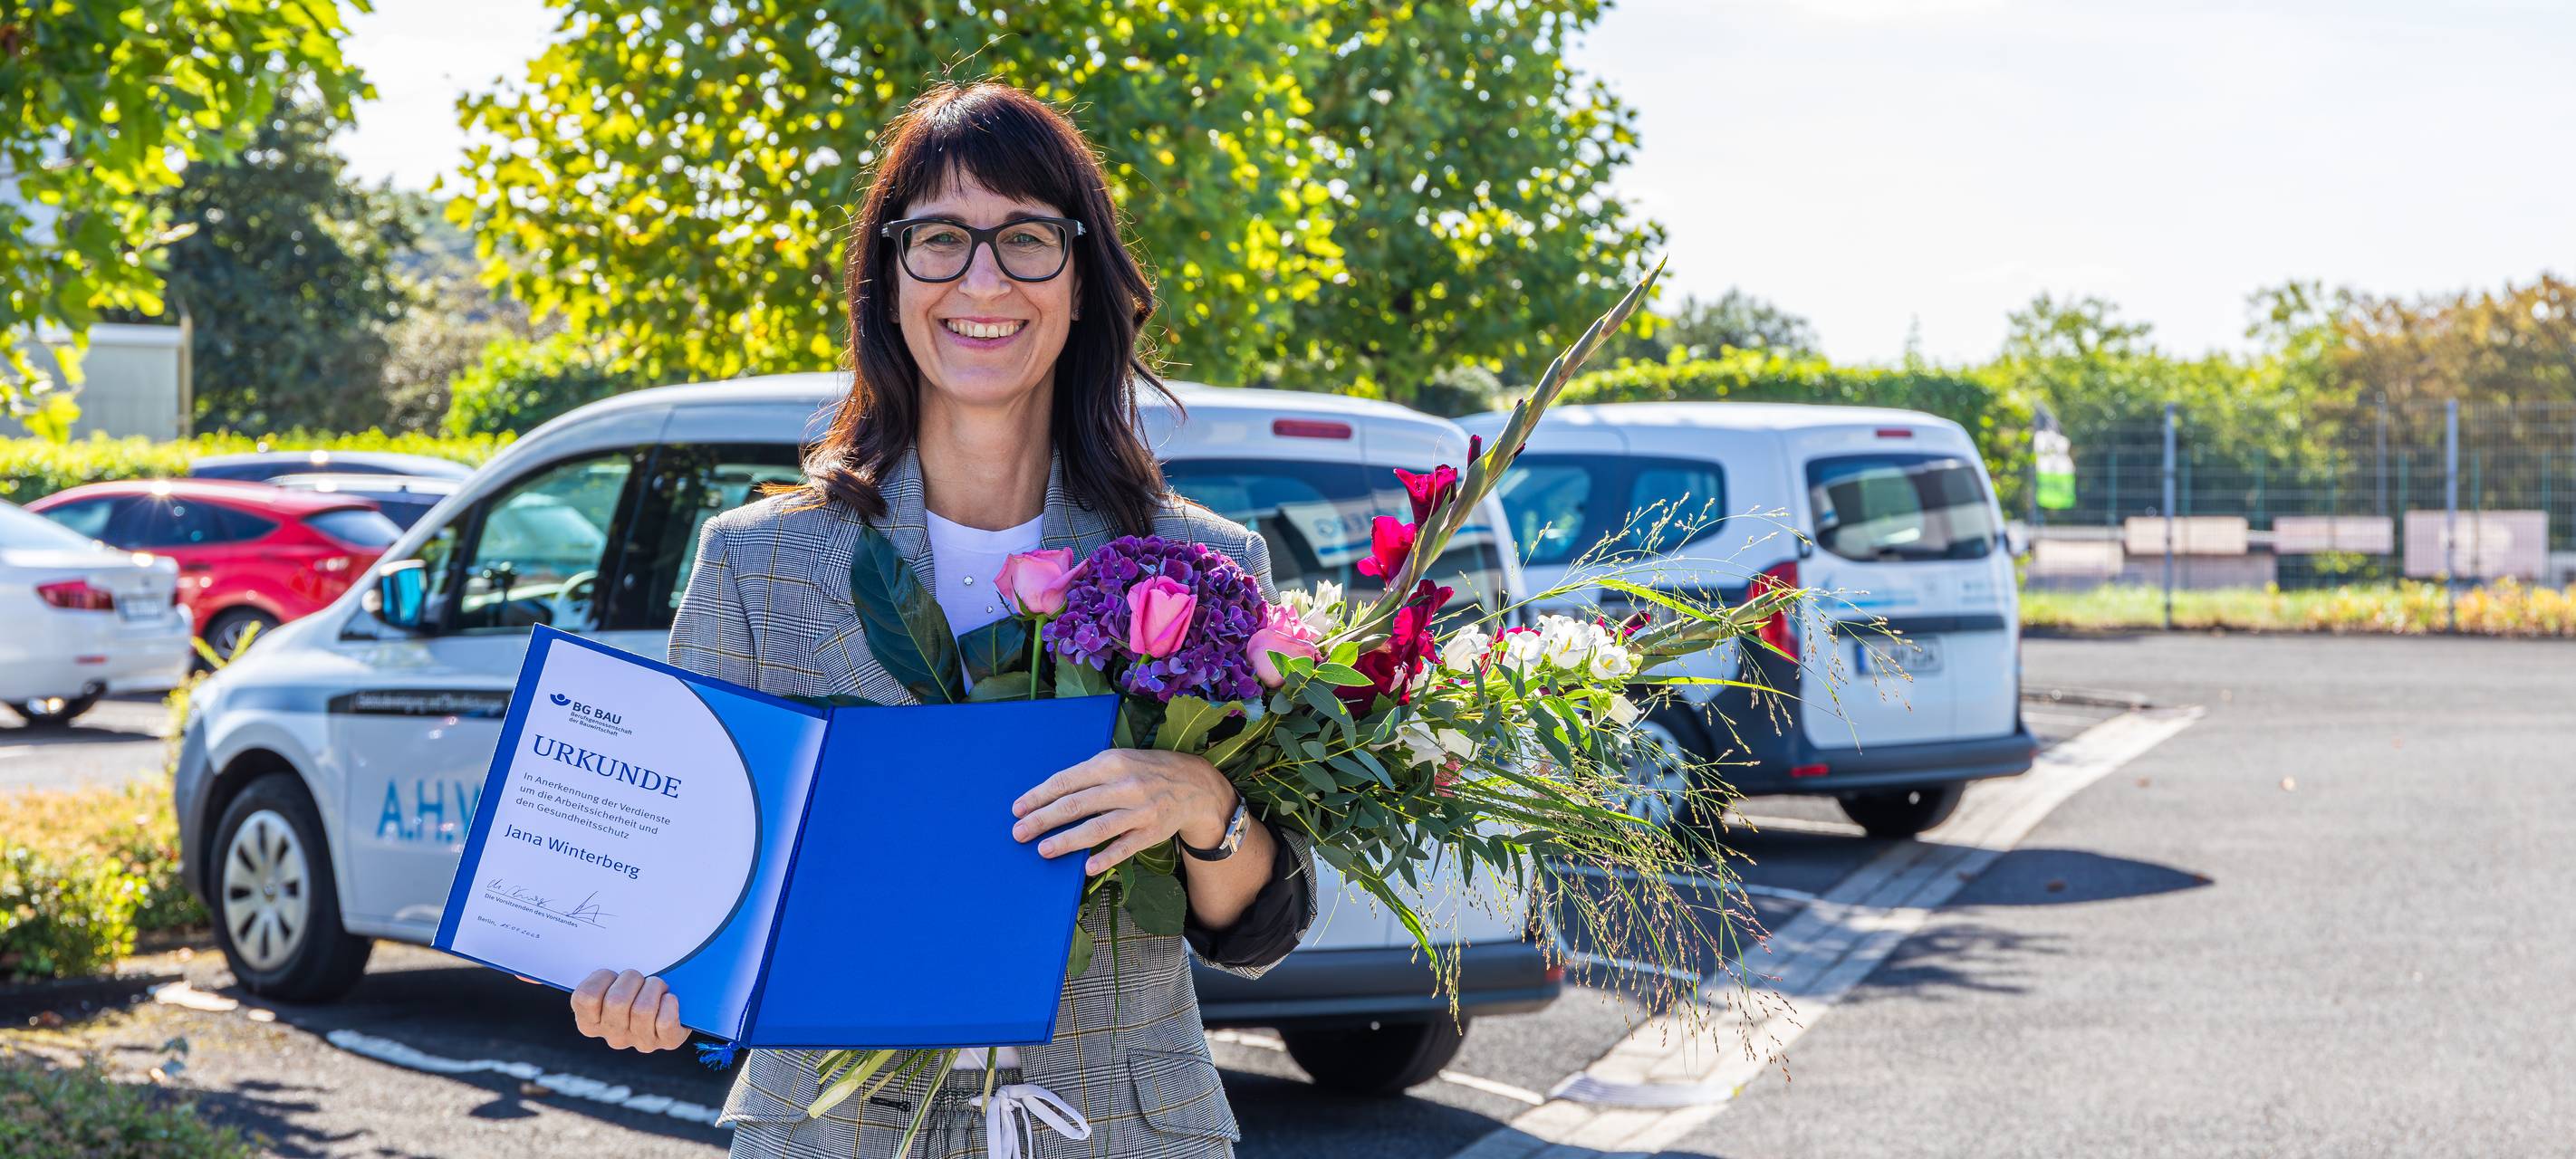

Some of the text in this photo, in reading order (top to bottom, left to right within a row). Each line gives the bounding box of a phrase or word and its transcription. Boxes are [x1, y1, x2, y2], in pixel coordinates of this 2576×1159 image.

[570, 711, 632, 735] Berufsgenossenschaft
[572, 701, 622, 724] BG BAU
[579, 720, 618, 737] Bauwirtschaft
[533, 734, 682, 799] URKUNDE
[519, 786, 658, 835] um die Arbeitssicherheit und
[523, 771, 671, 825] In Anerkennung der Verdienste
[515, 797, 630, 838] den Gesundheitsschutz
[505, 824, 641, 879] Jana Winterberg
[477, 915, 496, 926] Berlin,
[485, 893, 579, 928] Die Vorsitzenden des Vorstandes
